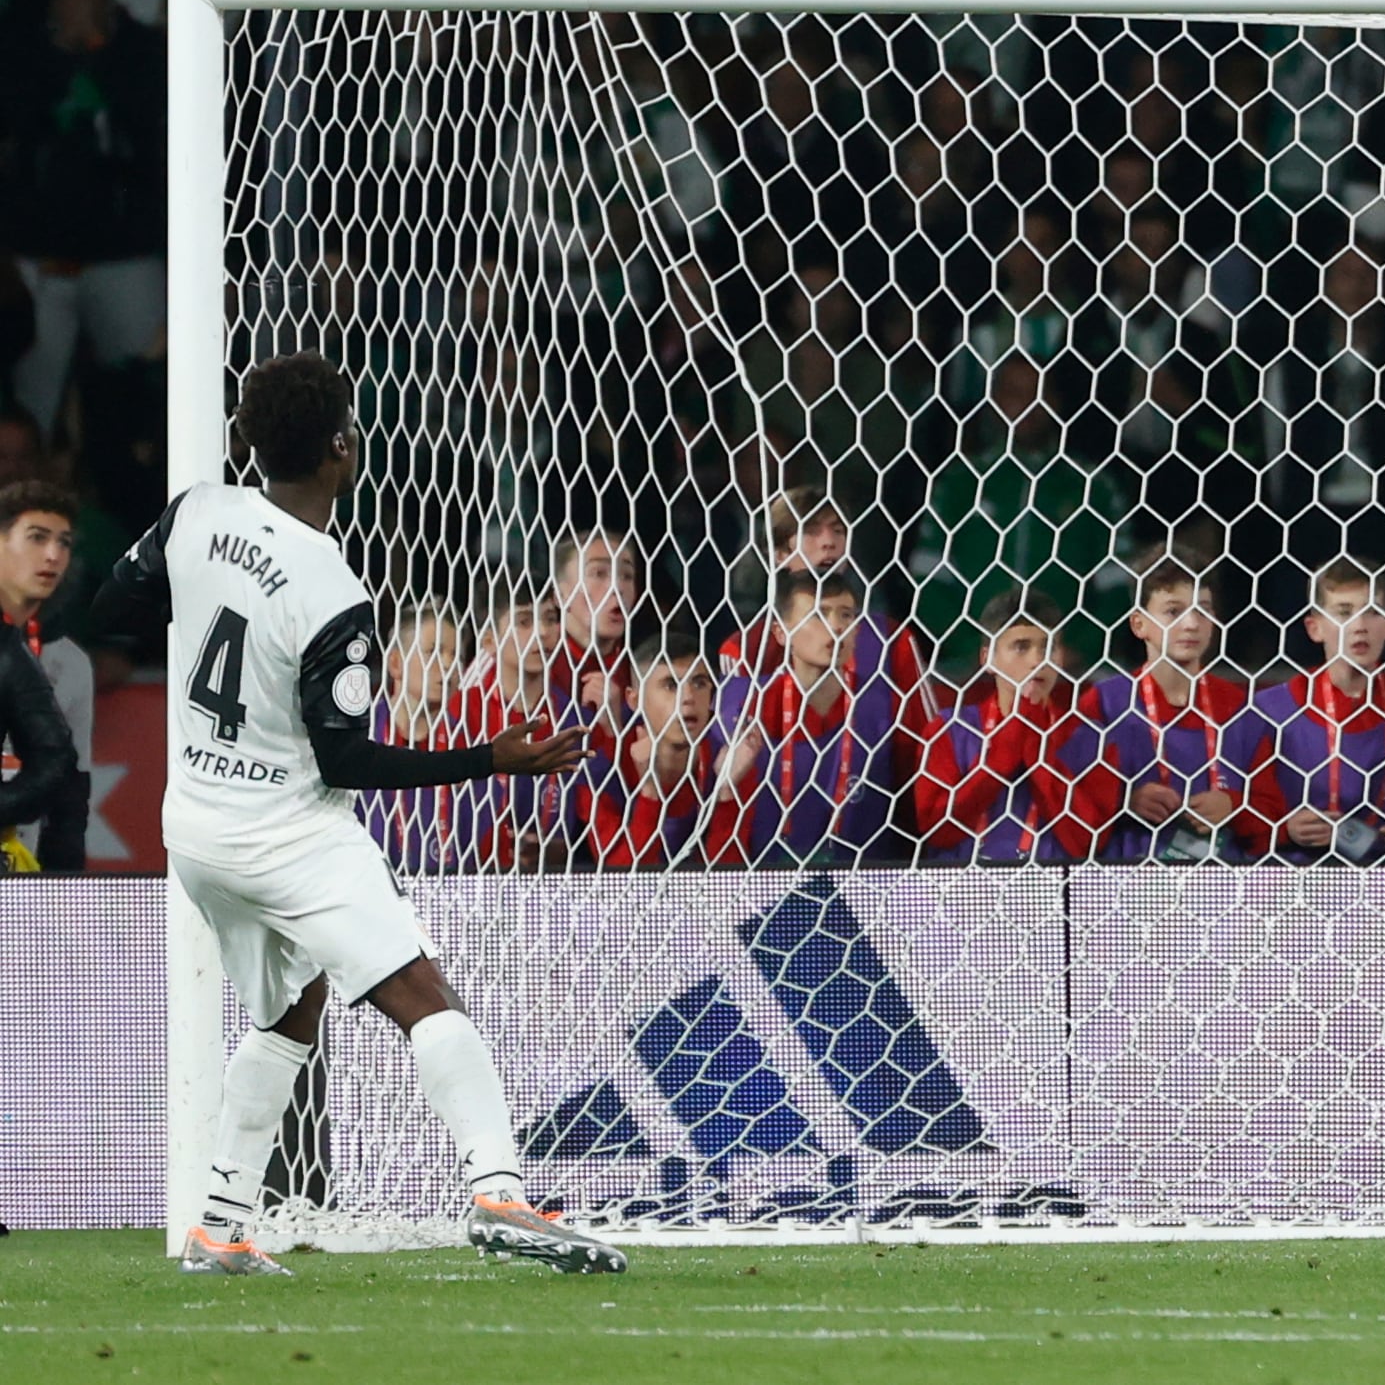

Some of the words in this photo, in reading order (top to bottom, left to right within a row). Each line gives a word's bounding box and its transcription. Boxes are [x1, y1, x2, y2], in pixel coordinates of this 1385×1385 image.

[208, 534, 288, 597] MUSAH
[187, 605, 248, 747] 4
[183, 745, 289, 786] MTRADE
